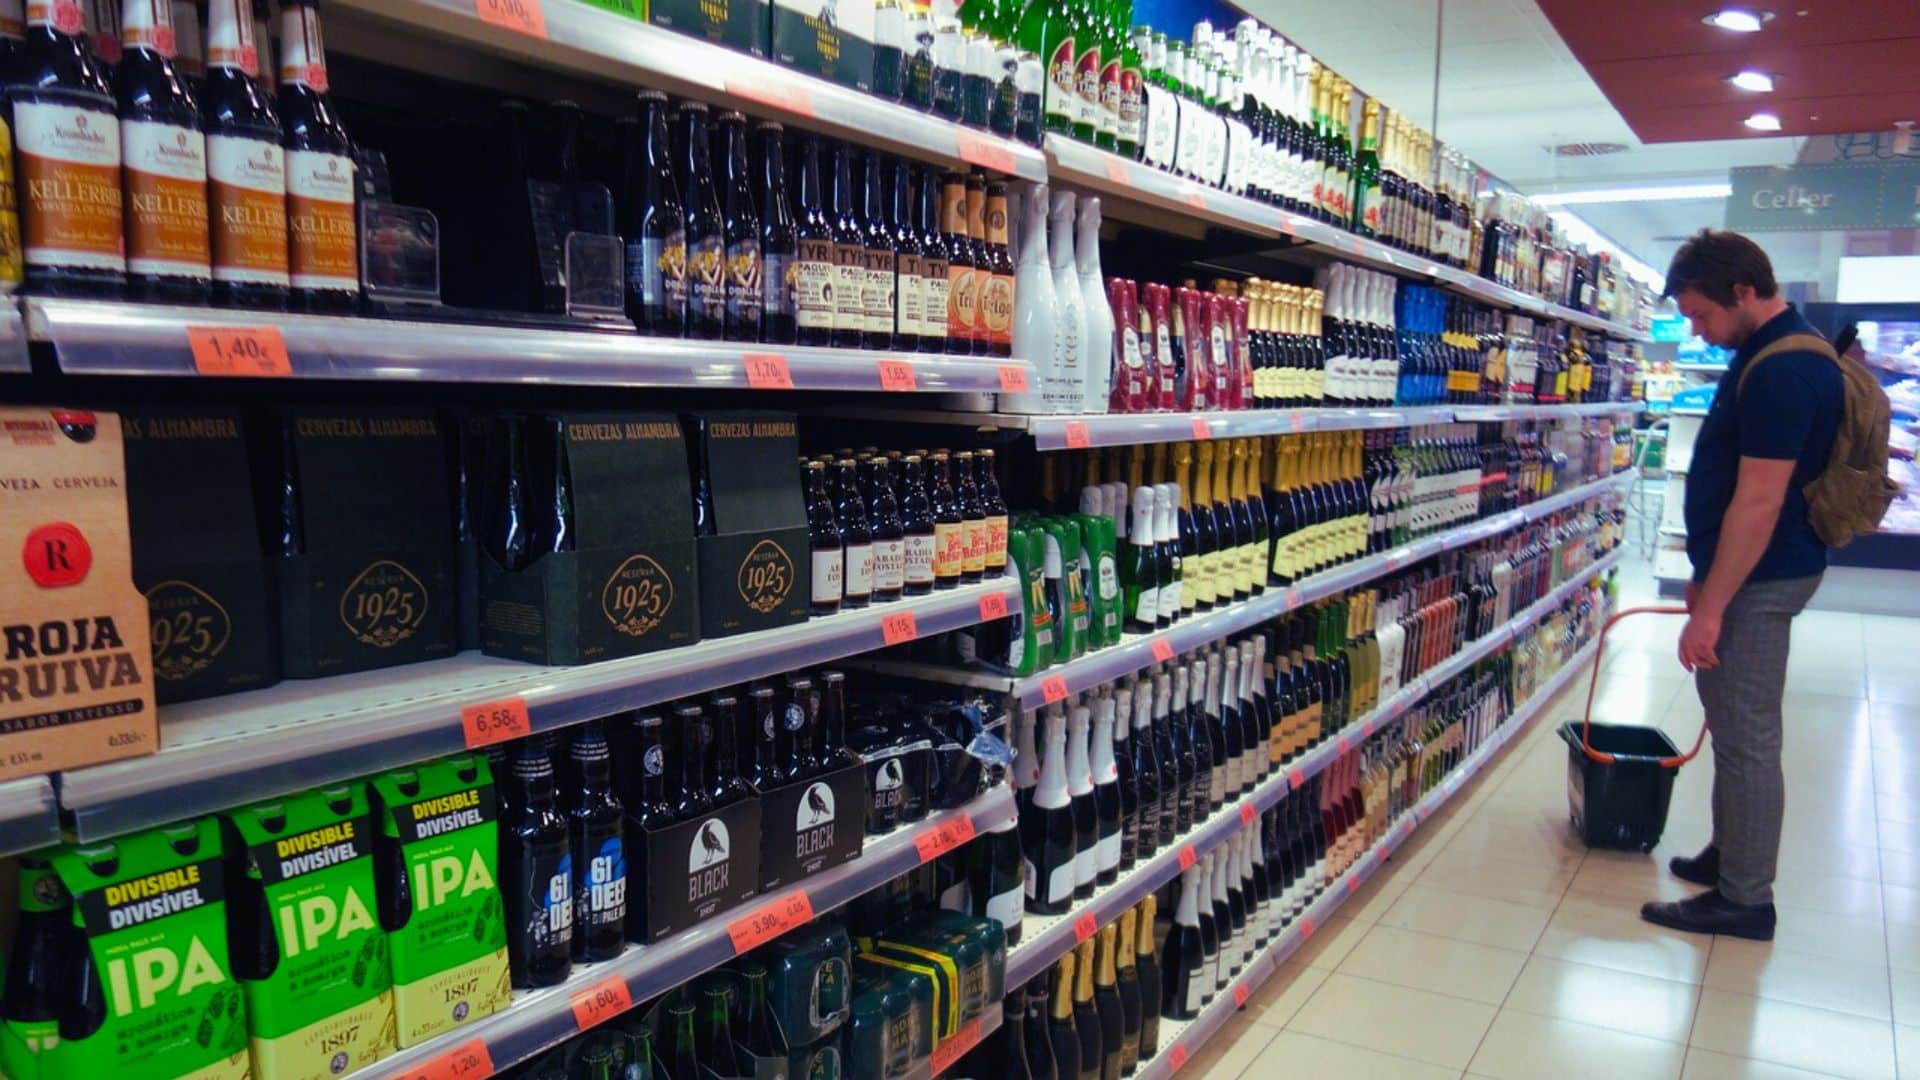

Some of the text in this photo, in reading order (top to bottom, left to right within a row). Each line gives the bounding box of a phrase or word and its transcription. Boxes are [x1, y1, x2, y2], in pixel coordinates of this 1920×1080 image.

[1752, 186, 1833, 209] Celler
[569, 422, 681, 441] CERVEZAS ALHAMBRA
[710, 422, 796, 438] CERVEZAS ALHAMBRA
[53, 476, 118, 489] CERVEJA
[44, 539, 72, 572] R
[747, 561, 785, 595] 1925
[355, 587, 414, 629] 1925
[614, 579, 663, 618] 1925
[3, 616, 124, 661] ROJA
[0, 652, 142, 702] RUIVA
[3, 702, 134, 731] SABOR INTENSO
[412, 790, 480, 820] DIVISIBLE
[277, 821, 355, 858] DIVISIBLE
[416, 809, 483, 839] DIVISÍVEL
[796, 823, 835, 858] BLACK
[281, 843, 358, 879] DIVISÍVEL
[105, 865, 200, 907] DIVISIBLE
[414, 847, 495, 911] IPA
[689, 863, 729, 902] BLACK
[109, 888, 204, 930] DIVISÍVEL
[279, 885, 376, 958] IPA
[107, 934, 227, 1017] IPA
[445, 977, 479, 1003] 1897
[321, 1025, 360, 1055] 1897
